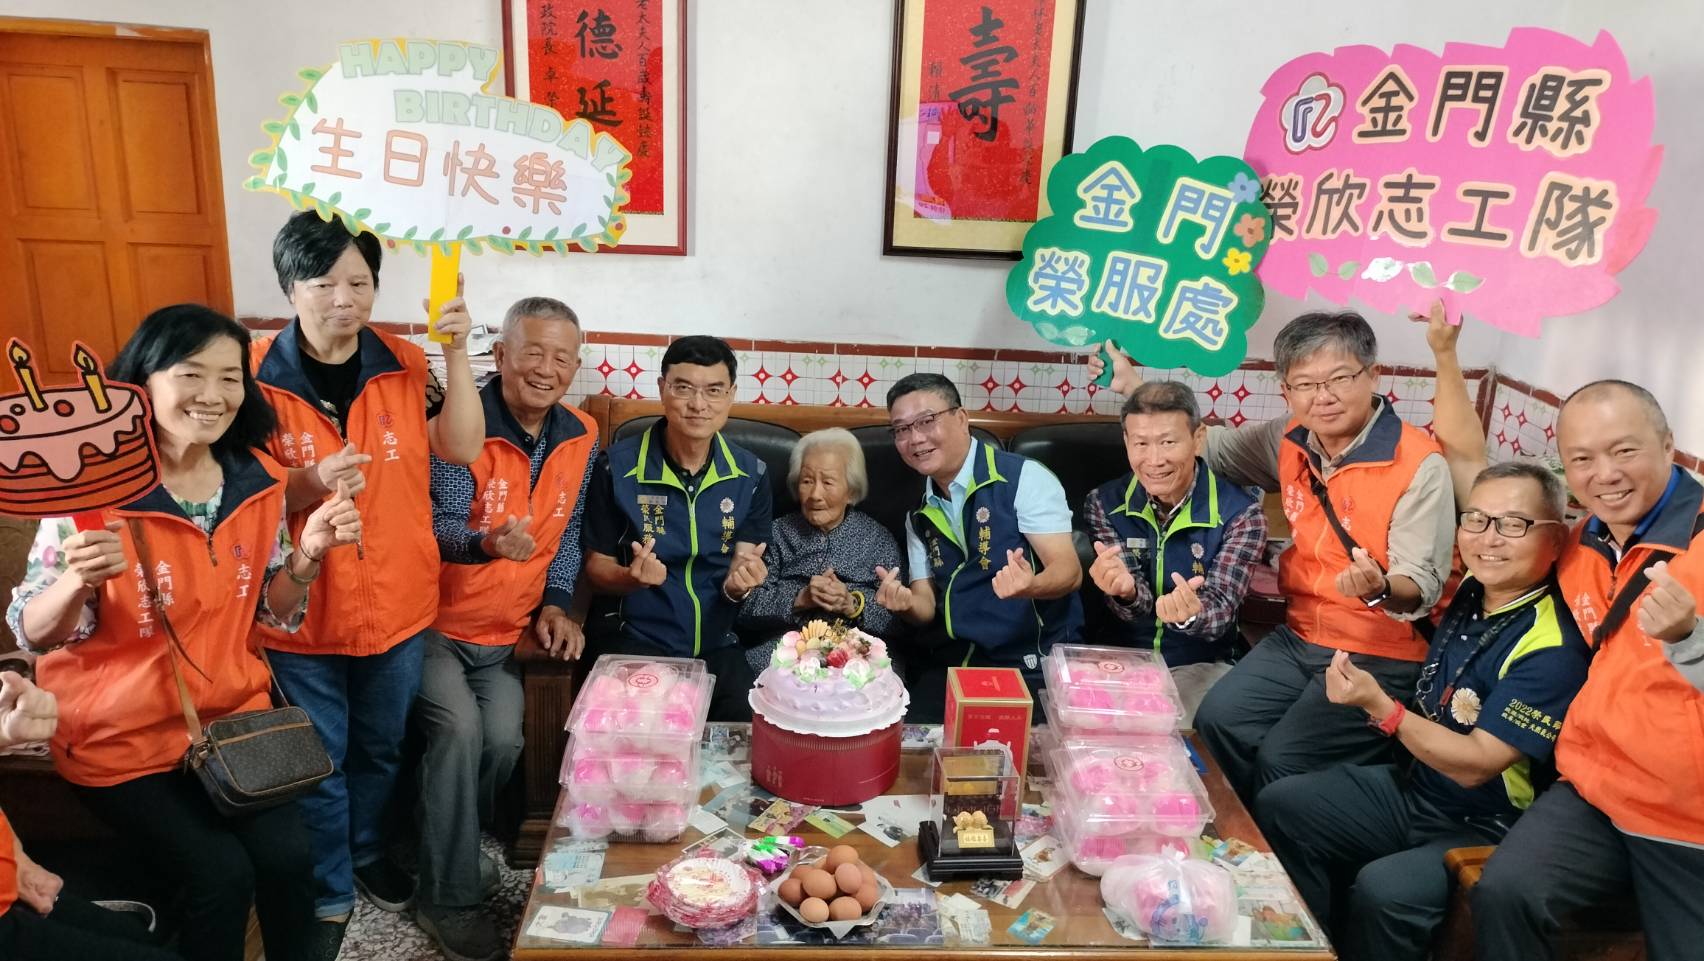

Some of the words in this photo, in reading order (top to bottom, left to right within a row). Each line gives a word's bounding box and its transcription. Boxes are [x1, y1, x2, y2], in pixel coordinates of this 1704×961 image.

[339, 41, 501, 80] HAPPY
[948, 6, 1020, 142] 壽
[393, 89, 631, 172] BIRTHDAY
[1356, 65, 1604, 151] 金門縣
[310, 118, 569, 216] 生日快樂
[1079, 164, 1238, 256] 金門
[1259, 172, 1614, 262] 榮欣志工隊
[1029, 249, 1237, 349] 榮服處
[383, 431, 400, 462] 志工
[552, 490, 567, 518] 志工
[236, 563, 252, 598] 志工
[977, 525, 992, 571] 輔導會
